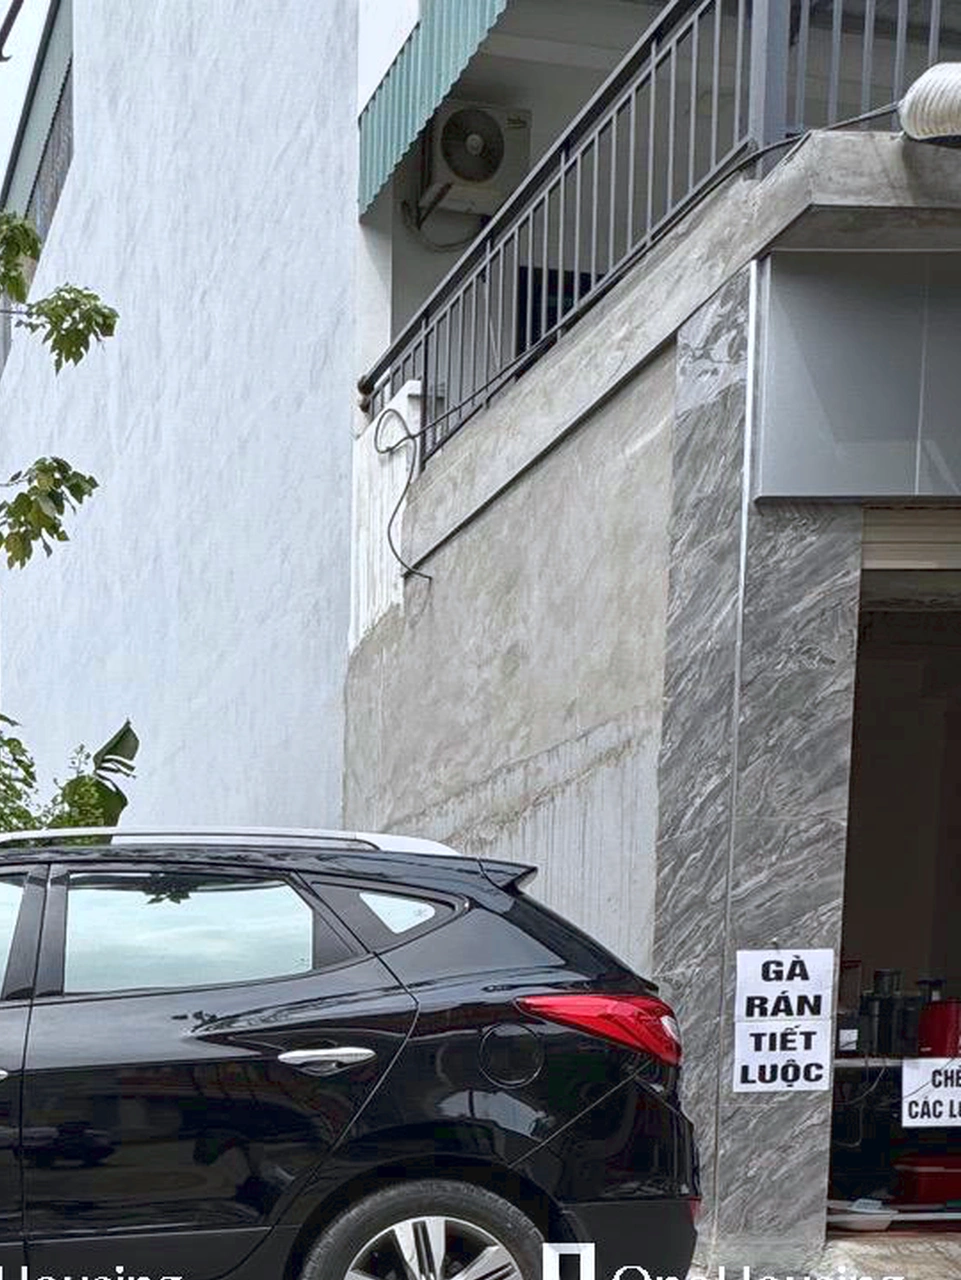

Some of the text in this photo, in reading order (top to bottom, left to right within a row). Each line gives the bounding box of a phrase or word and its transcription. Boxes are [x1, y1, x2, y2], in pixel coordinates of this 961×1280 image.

[761, 955, 810, 982] GÀ
[745, 990, 822, 1017] RÁN
[749, 1024, 817, 1052] TIẾT
[740, 1059, 824, 1088] LUỘC
[908, 1095, 943, 1119] CÁC
